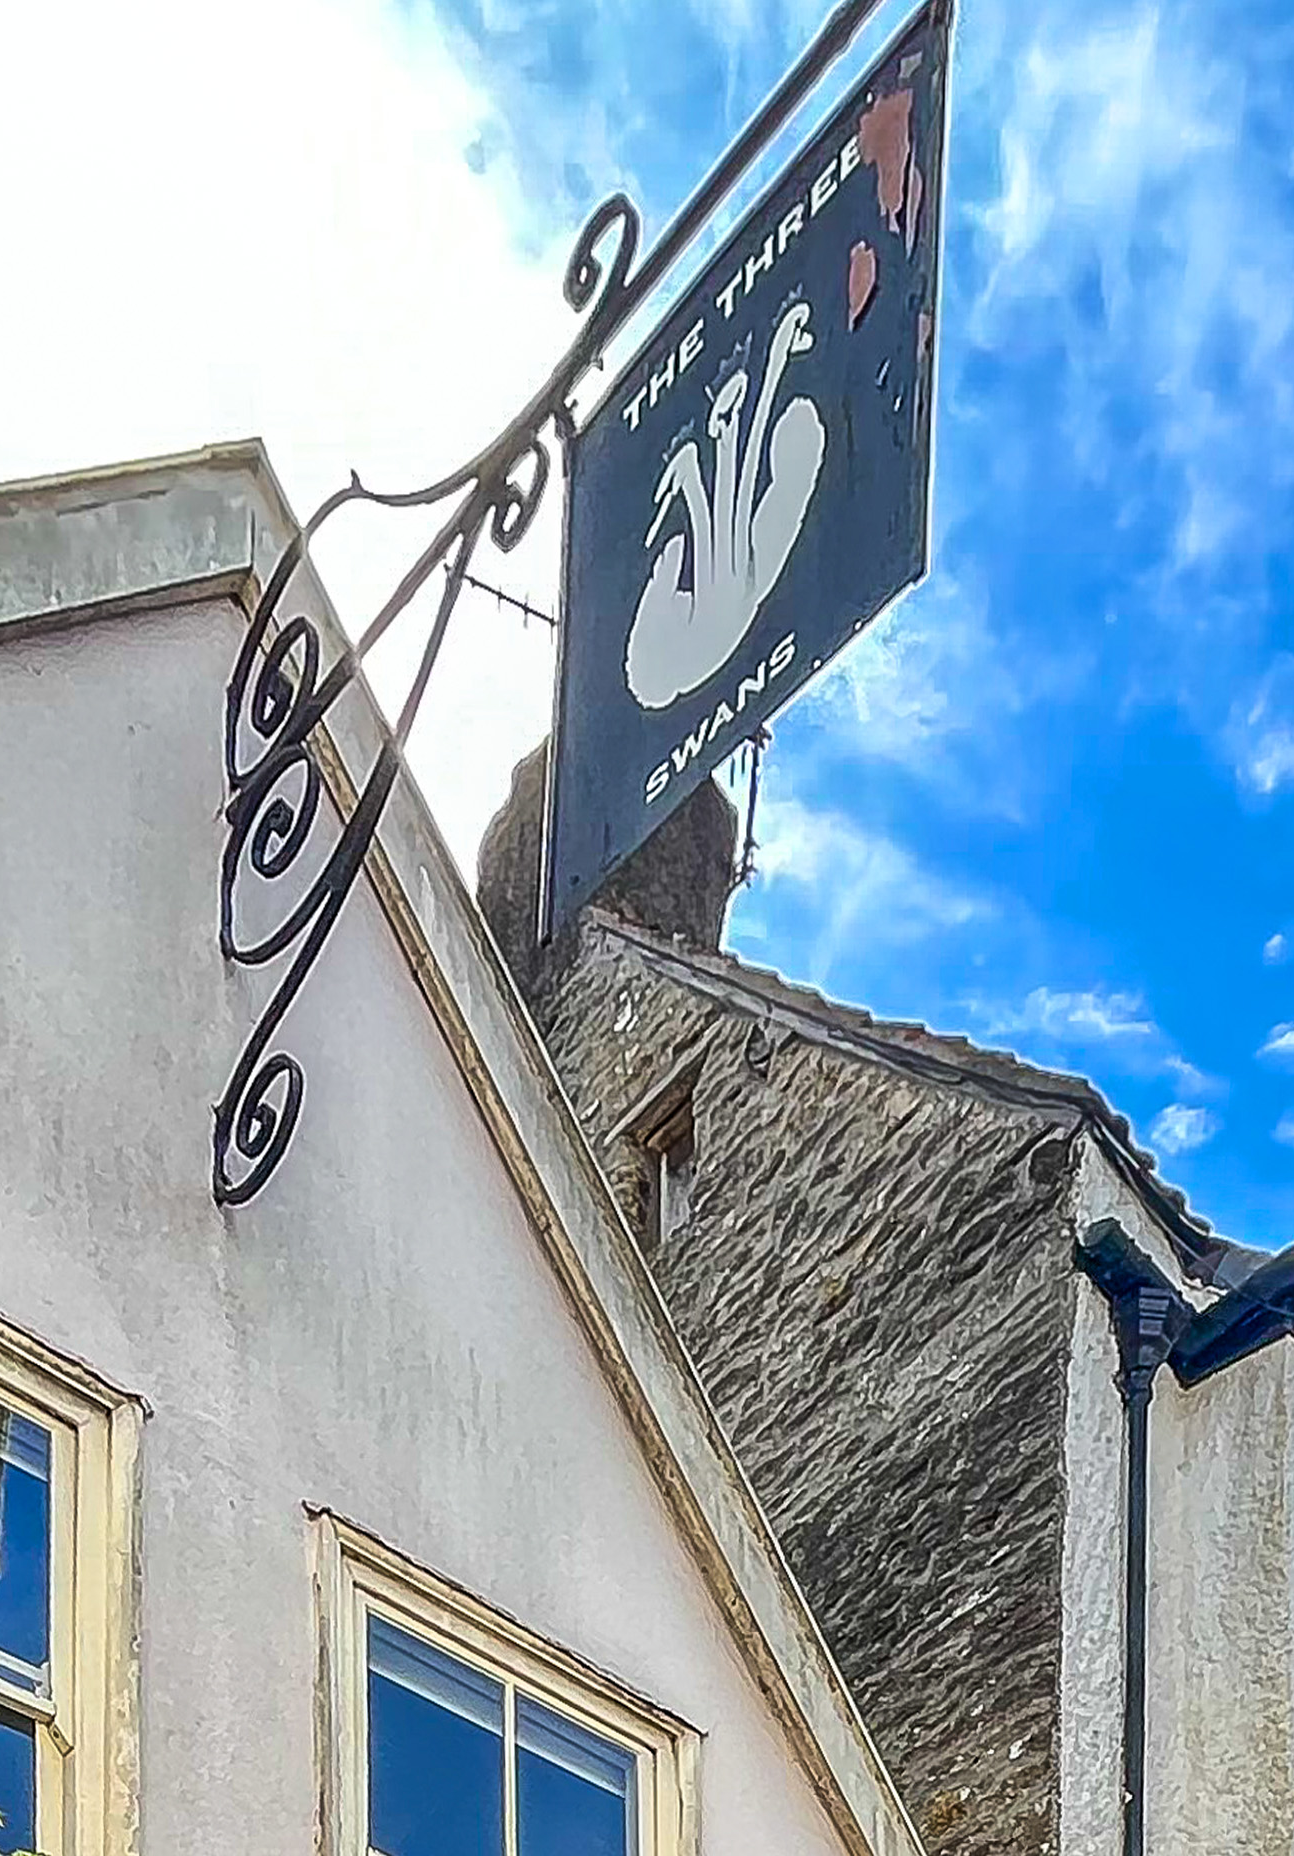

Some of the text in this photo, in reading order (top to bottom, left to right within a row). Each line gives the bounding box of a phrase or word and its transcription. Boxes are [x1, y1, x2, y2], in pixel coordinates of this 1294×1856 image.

[623, 134, 861, 432] THE THREE
[646, 631, 796, 804] SWANS
